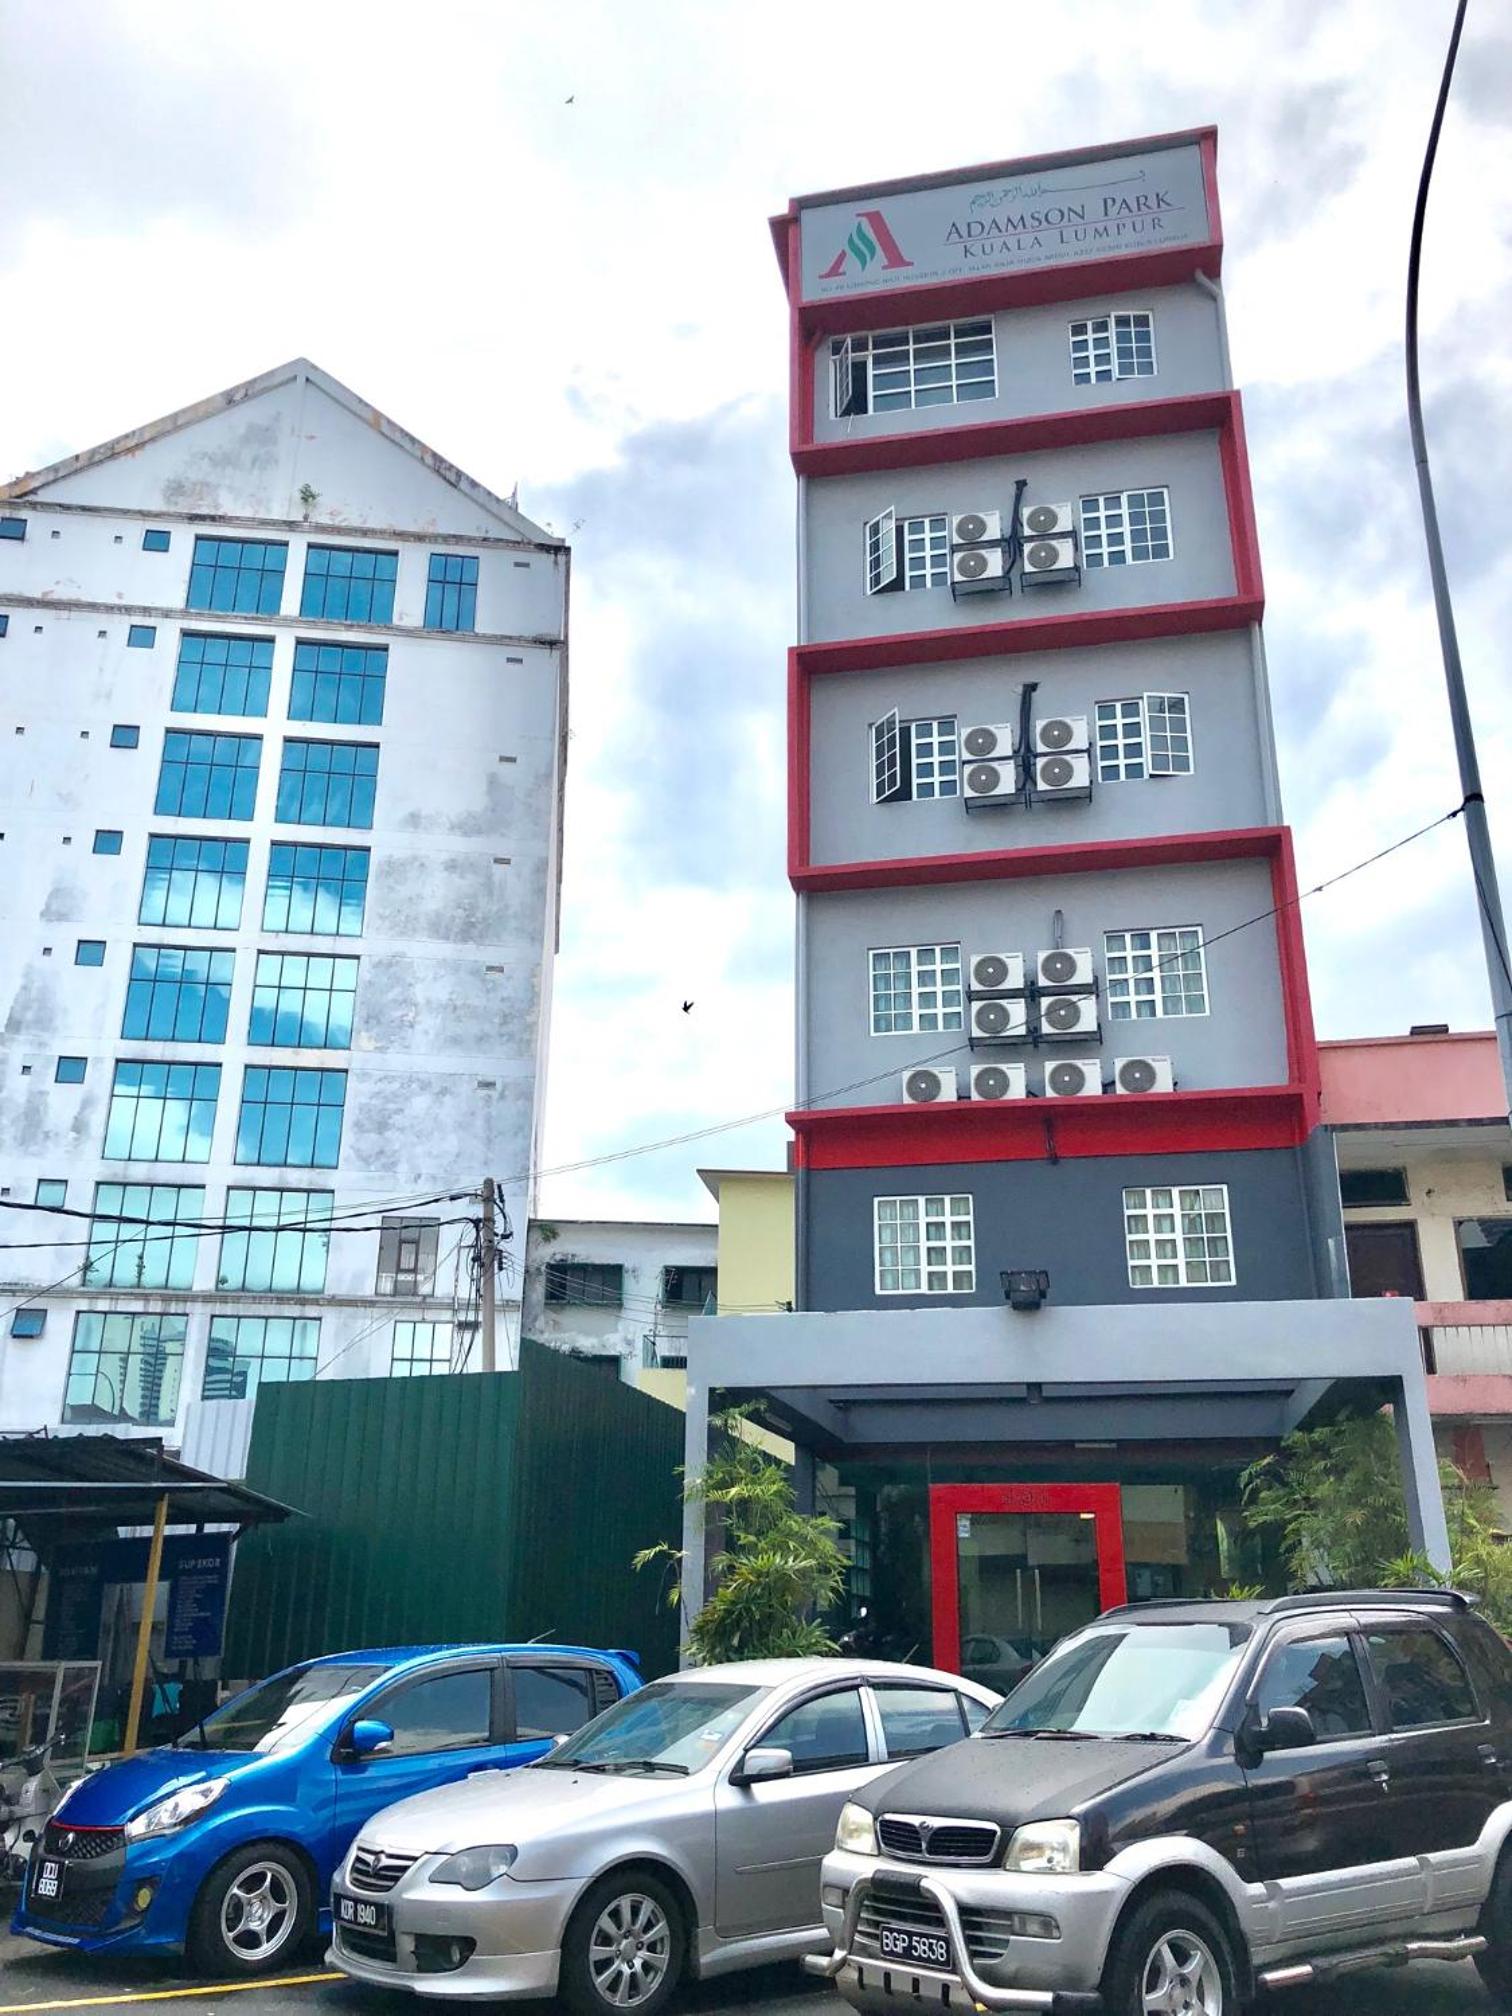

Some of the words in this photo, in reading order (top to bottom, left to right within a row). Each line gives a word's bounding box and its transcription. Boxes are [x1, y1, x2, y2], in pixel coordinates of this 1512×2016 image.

[945, 204, 1087, 242] ADAMSON
[1102, 190, 1174, 218] PARK
[963, 236, 1043, 259] KUALA
[1059, 217, 1164, 245] LUMPUR
[357, 1903, 376, 1925] 1940
[882, 1931, 908, 1953] BGP
[911, 1936, 947, 1961] 5838
